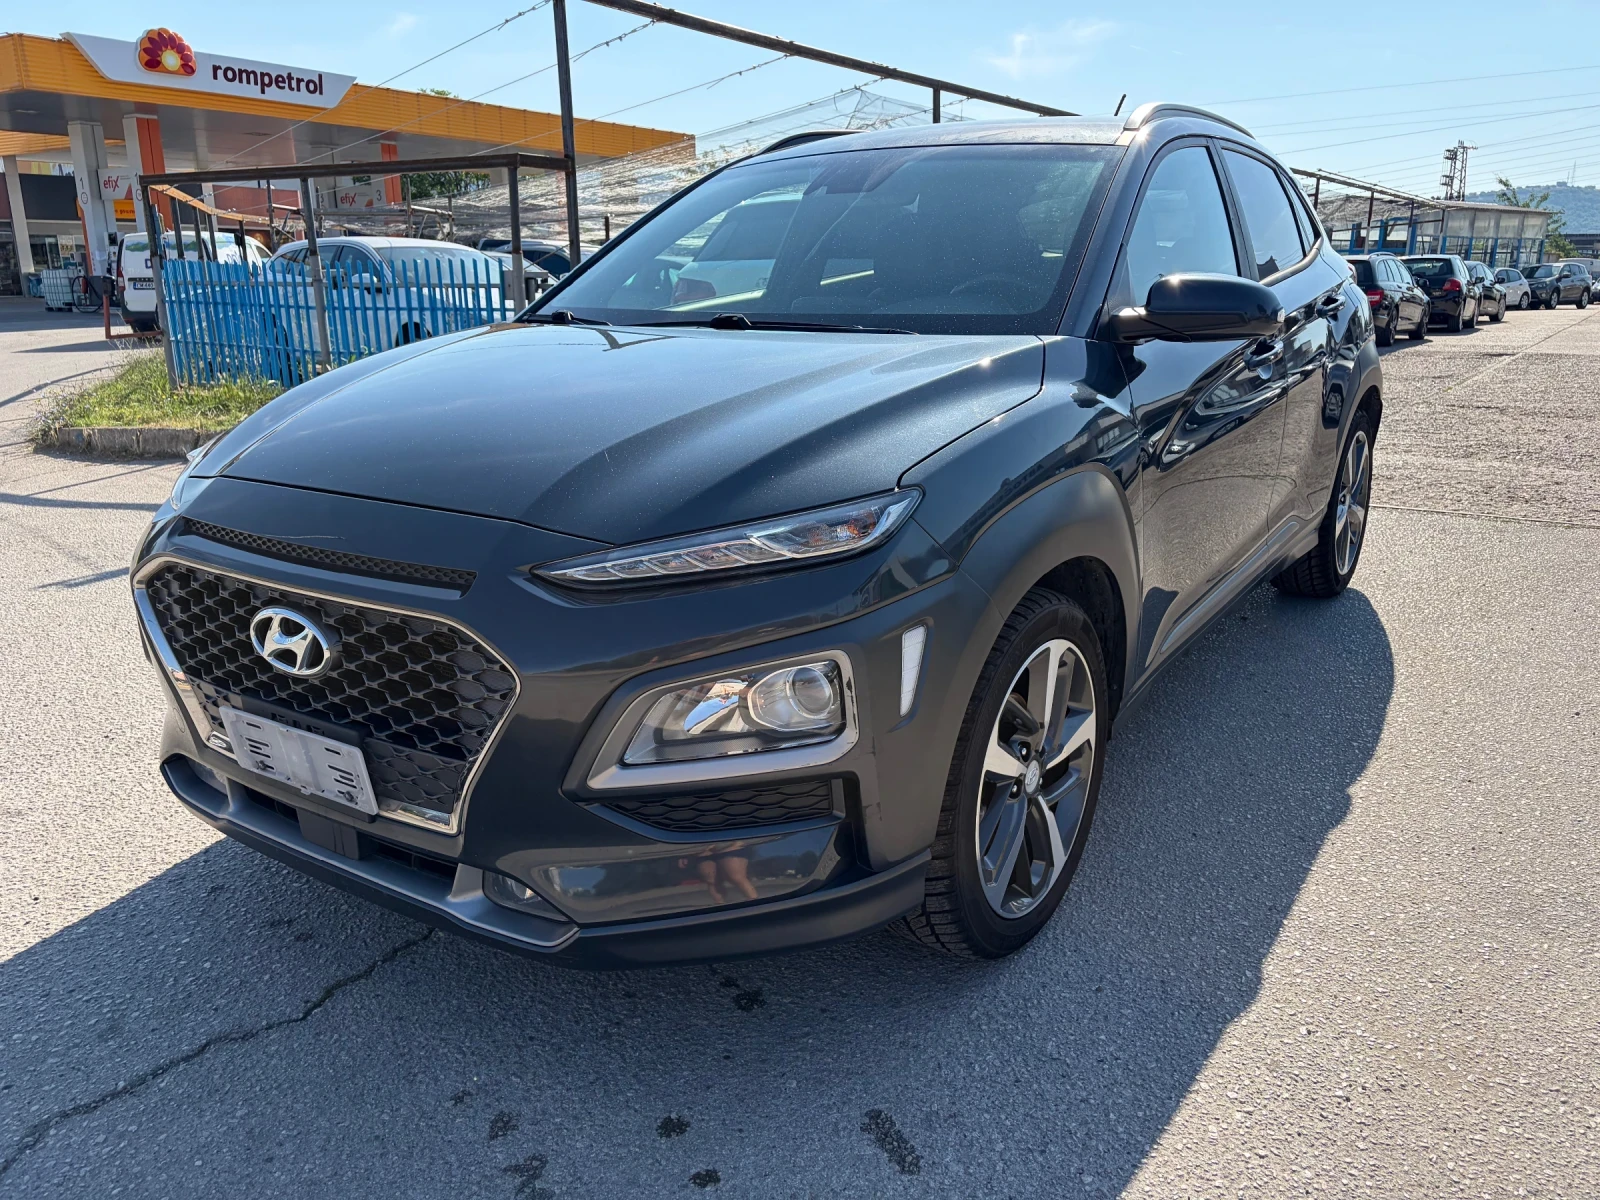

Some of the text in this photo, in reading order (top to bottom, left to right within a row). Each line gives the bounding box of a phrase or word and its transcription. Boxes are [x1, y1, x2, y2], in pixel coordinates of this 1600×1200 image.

[212, 64, 323, 95] rompetrol
[340, 192, 357, 207] efix
[376, 189, 382, 202] 3
